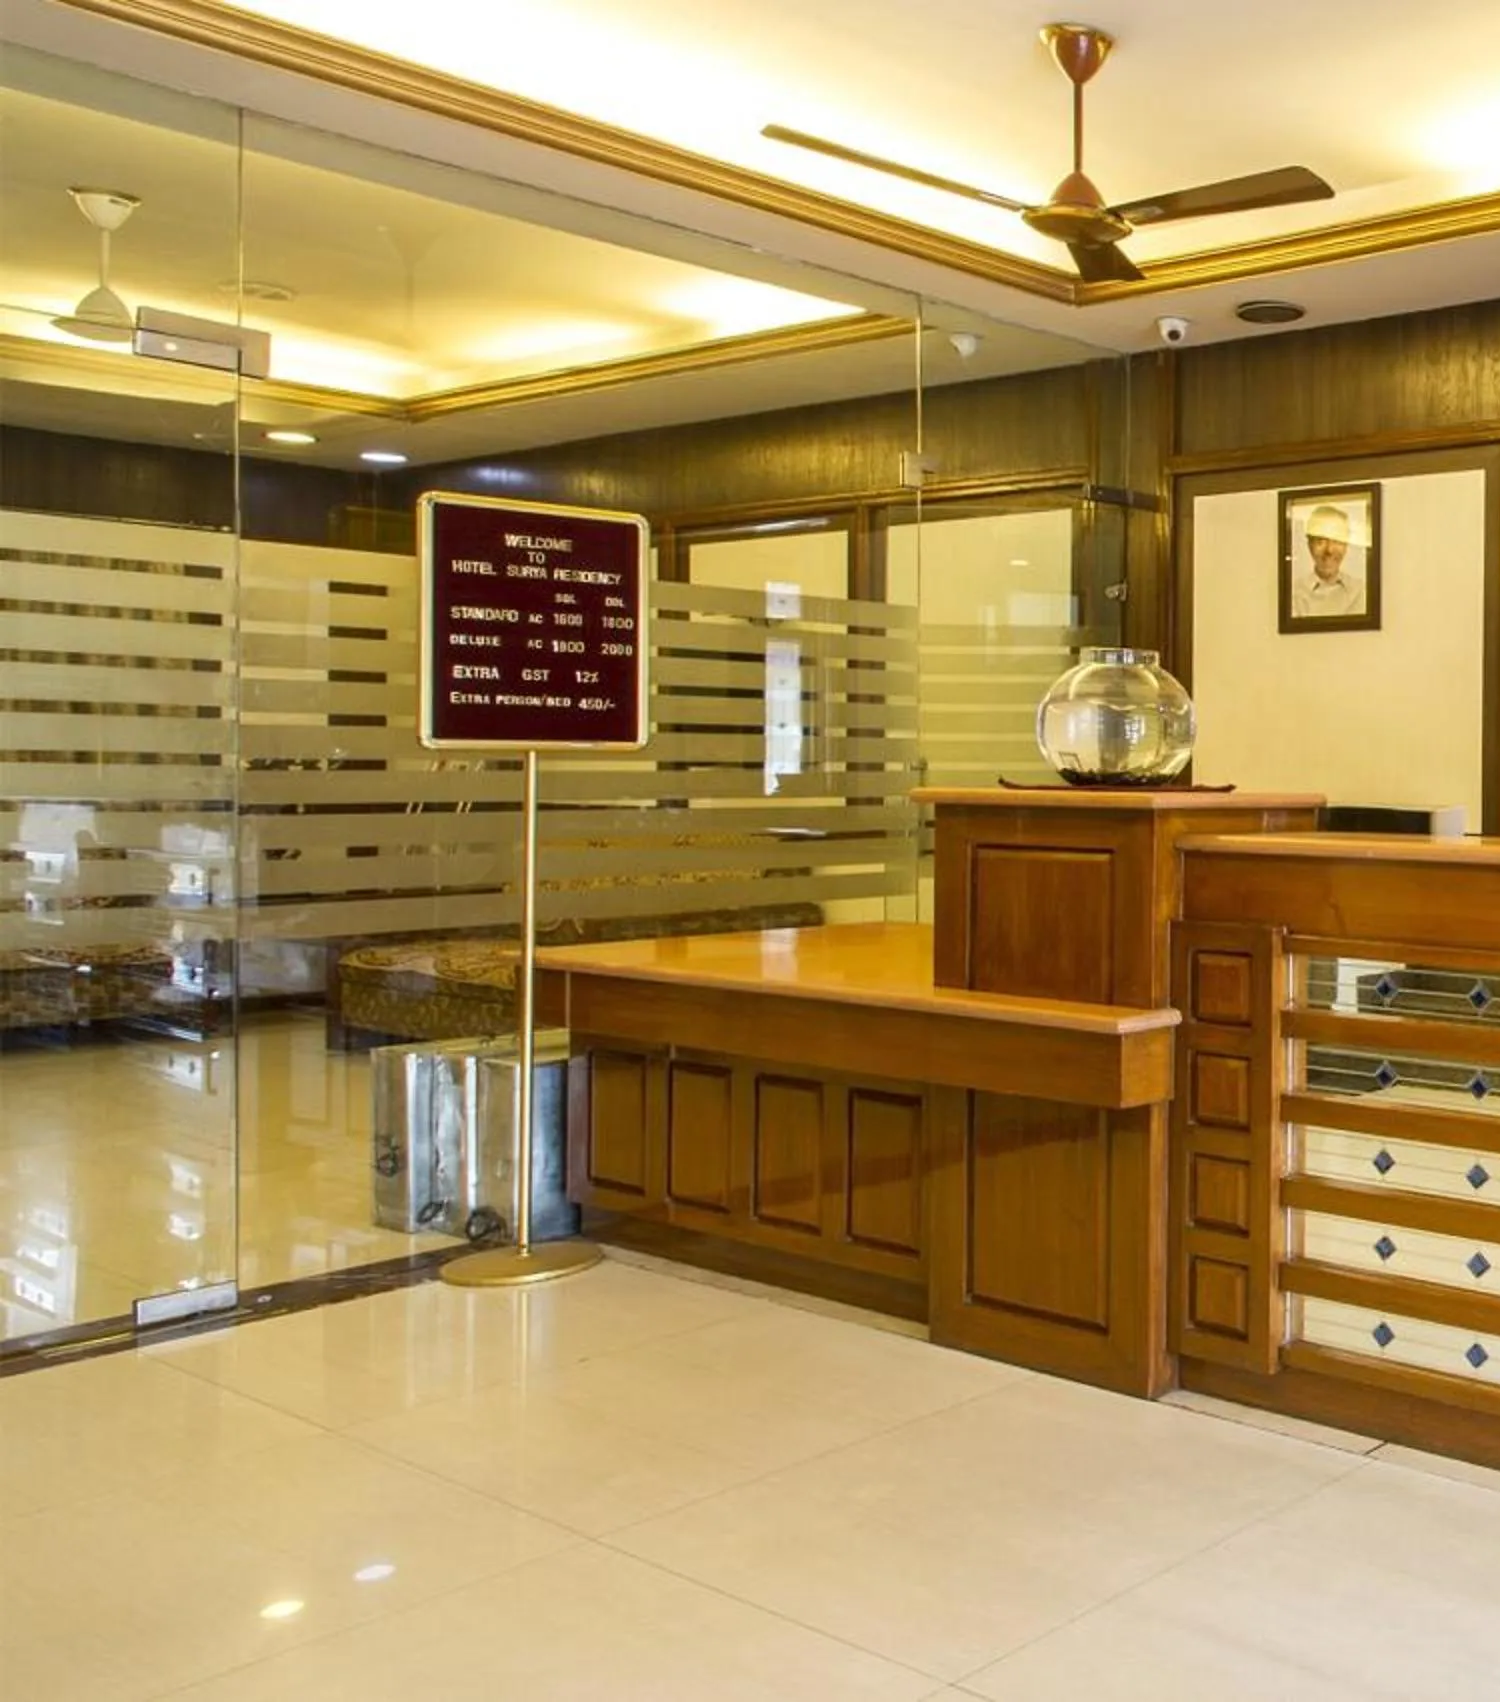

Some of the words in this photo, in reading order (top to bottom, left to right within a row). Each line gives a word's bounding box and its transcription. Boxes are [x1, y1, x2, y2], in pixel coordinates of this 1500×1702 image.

[504, 533, 574, 551] WELCOME
[527, 552, 545, 564] TO
[451, 559, 498, 576] HOTEL
[506, 564, 548, 580] SURYA
[553, 568, 622, 586] RESIDENCY
[450, 605, 519, 622] STANDARD
[528, 614, 543, 625] AC
[450, 634, 501, 647] DELUXE
[601, 643, 633, 656] 2000
[452, 664, 501, 680] EXTRA
[521, 668, 550, 682] GST
[575, 670, 599, 684] 12%
